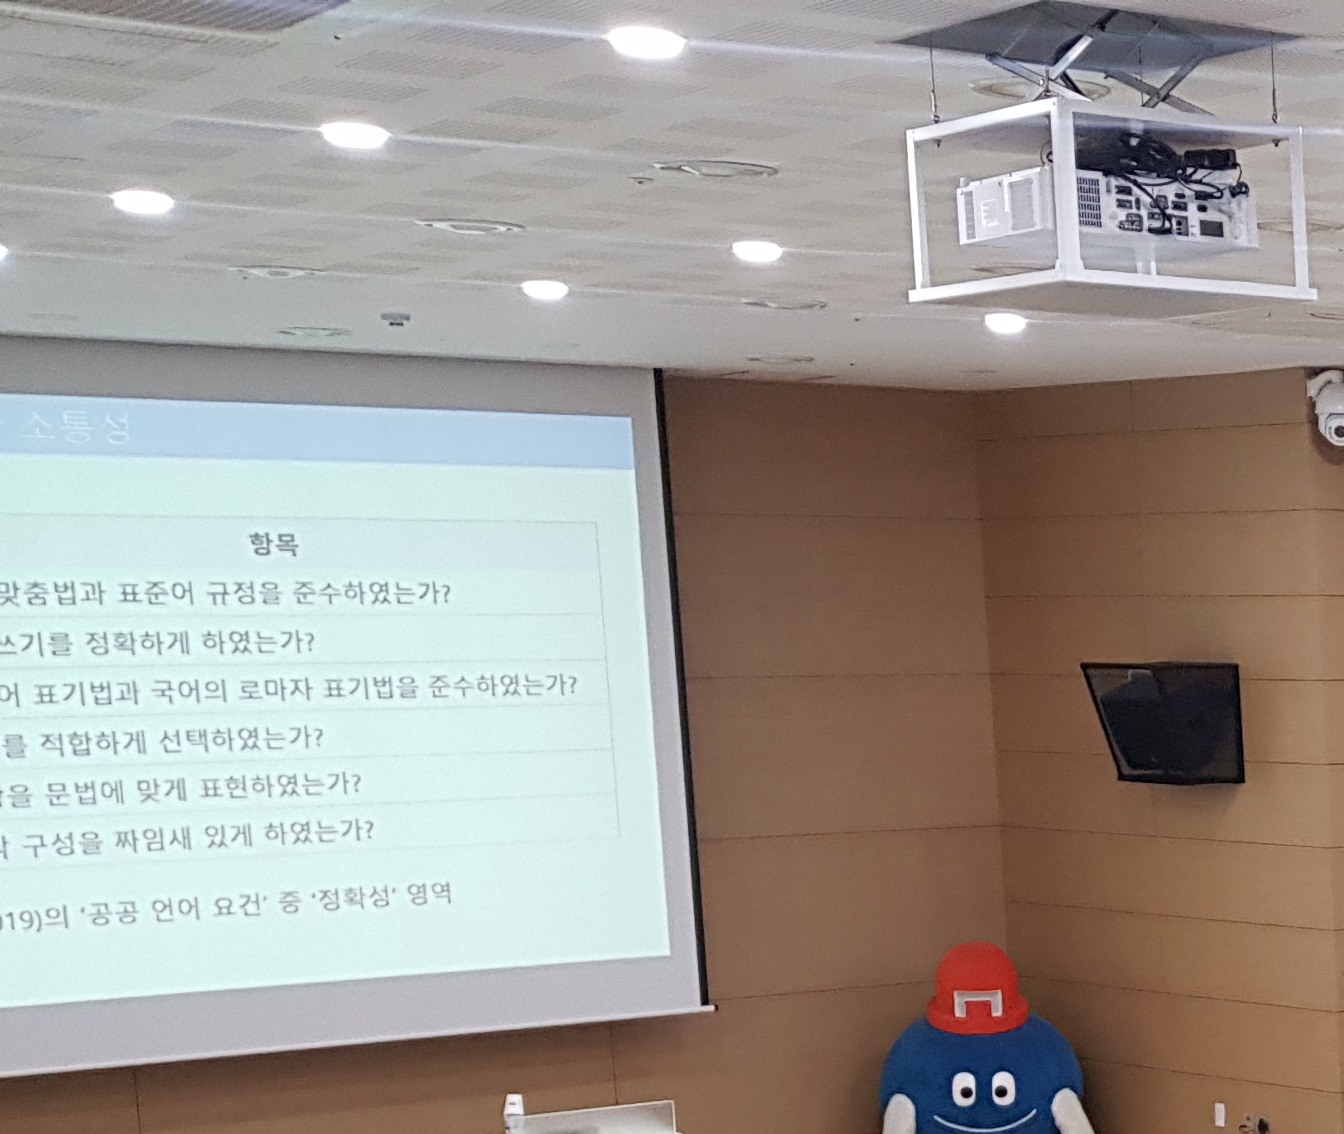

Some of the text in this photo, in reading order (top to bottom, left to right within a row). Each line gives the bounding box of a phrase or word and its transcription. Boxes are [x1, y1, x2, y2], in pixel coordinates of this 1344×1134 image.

[20, 409, 131, 445] 소통성
[249, 531, 299, 557] 항목
[0, 580, 452, 606] 맞춤법과 표준어 규정을 준수하였는가?
[85, 631, 191, 656] 정확하게
[202, 630, 315, 654] 하였는가?
[34, 680, 139, 706] 표기법과
[152, 678, 228, 704] 국어의
[239, 677, 313, 702] 로마자
[324, 675, 419, 701] 표기법을
[428, 673, 578, 698] 준수하였는가?
[2, 725, 324, 758] 를 적합하게 선택하였는가?
[45, 780, 125, 806] 문법에
[137, 777, 188, 804] 맞게
[200, 772, 362, 799] 표현하였는가?
[23, 831, 103, 859] 구성을
[115, 826, 192, 853] 짜임새
[204, 822, 253, 849] 있게
[264, 818, 375, 846] 하였는가?
[0, 904, 69, 933] 19)의
[152, 896, 201, 923] 언어
[407, 881, 452, 906] 영역
